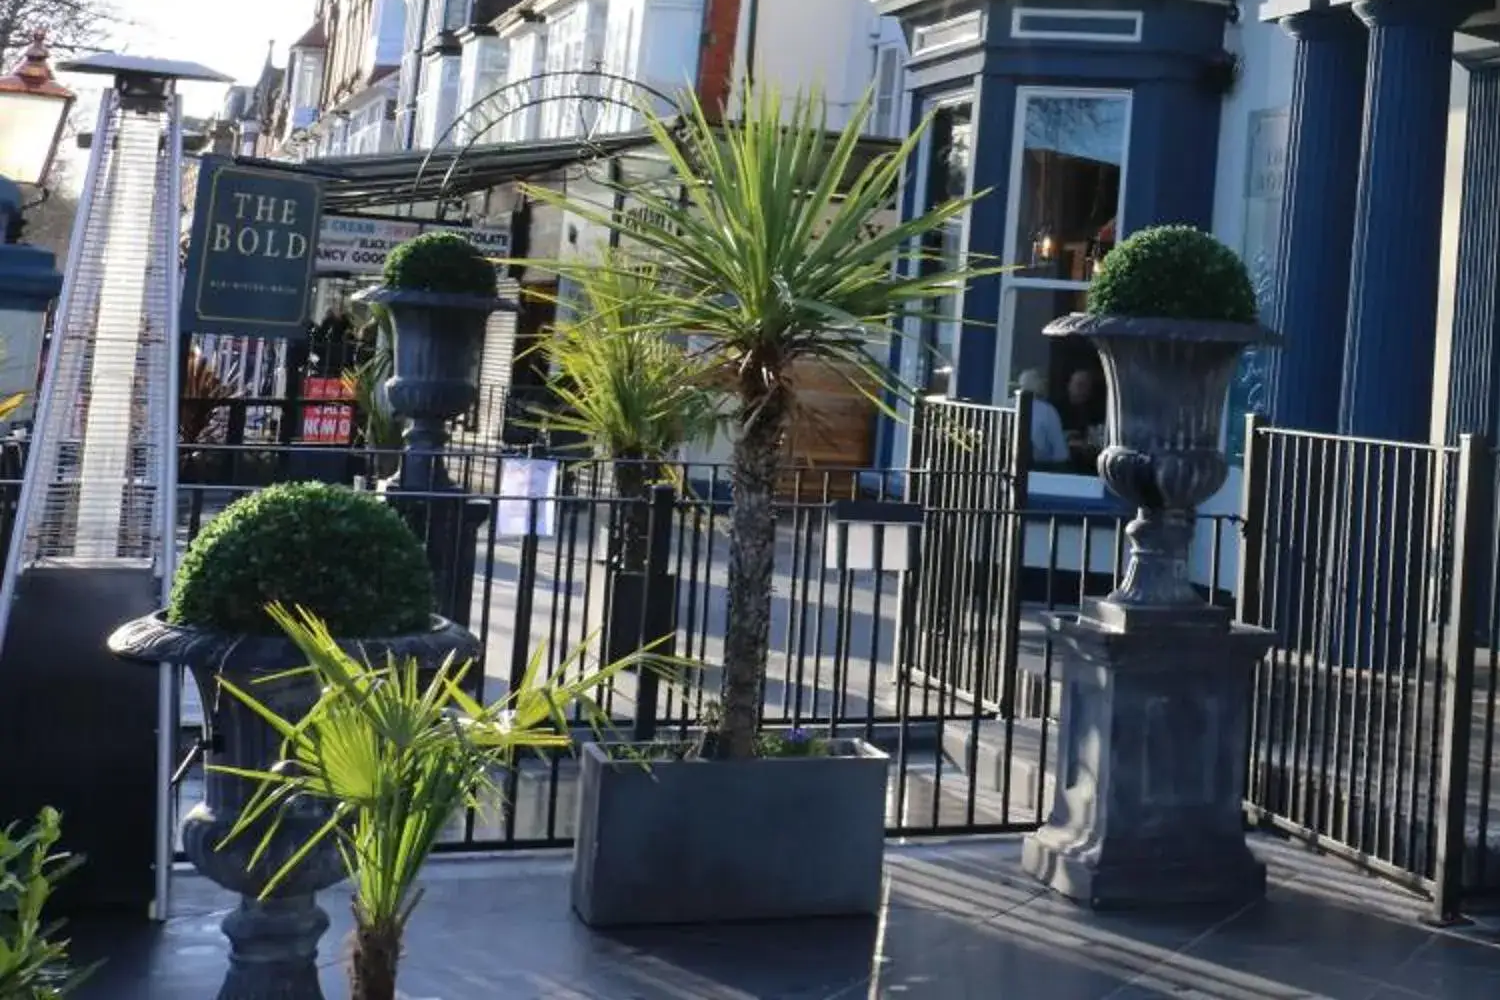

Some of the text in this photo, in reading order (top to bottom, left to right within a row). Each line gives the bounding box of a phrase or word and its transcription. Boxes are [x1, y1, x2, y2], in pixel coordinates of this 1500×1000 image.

[233, 192, 299, 225] THE
[212, 223, 308, 260] BOLD
[316, 246, 347, 262] ANCY
[339, 418, 351, 435] O
